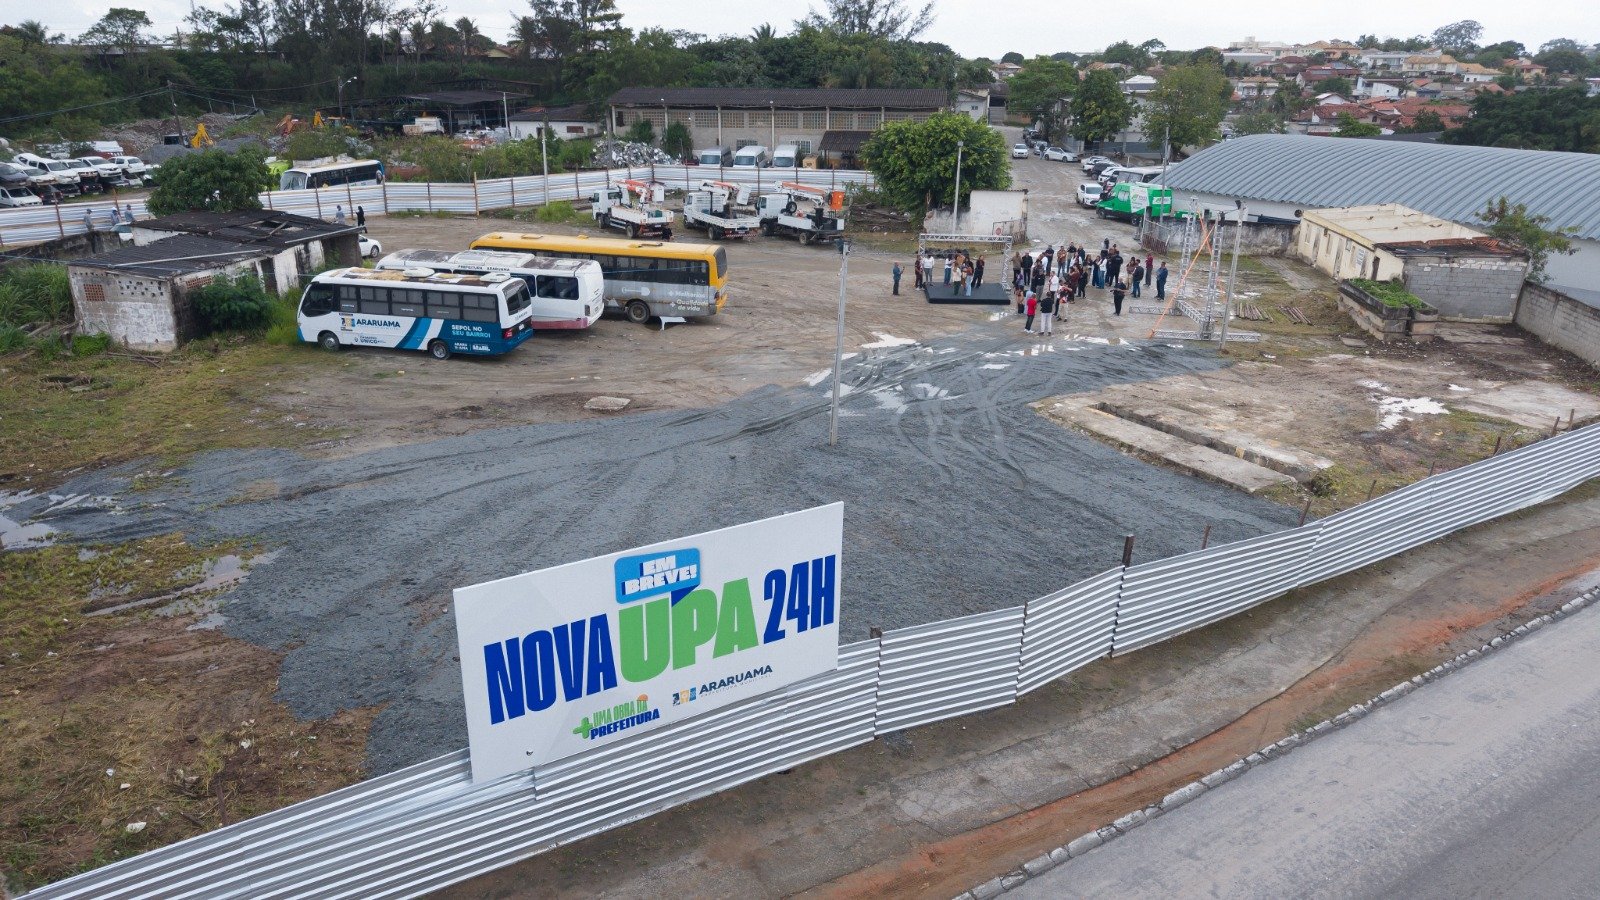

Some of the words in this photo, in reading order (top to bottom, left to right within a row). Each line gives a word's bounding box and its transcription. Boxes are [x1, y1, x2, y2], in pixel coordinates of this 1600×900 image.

[356, 318, 401, 328] ARARUAMA
[622, 564, 698, 596] BREVE!
[640, 555, 676, 577] EM
[484, 613, 618, 725] NOVA
[618, 577, 759, 683] UPA
[763, 554, 837, 645] 24H
[699, 664, 773, 695] ARARUAMA
[590, 708, 660, 740] PREFEITURA
[593, 707, 612, 727] UMA
[613, 700, 635, 721] OBRA
